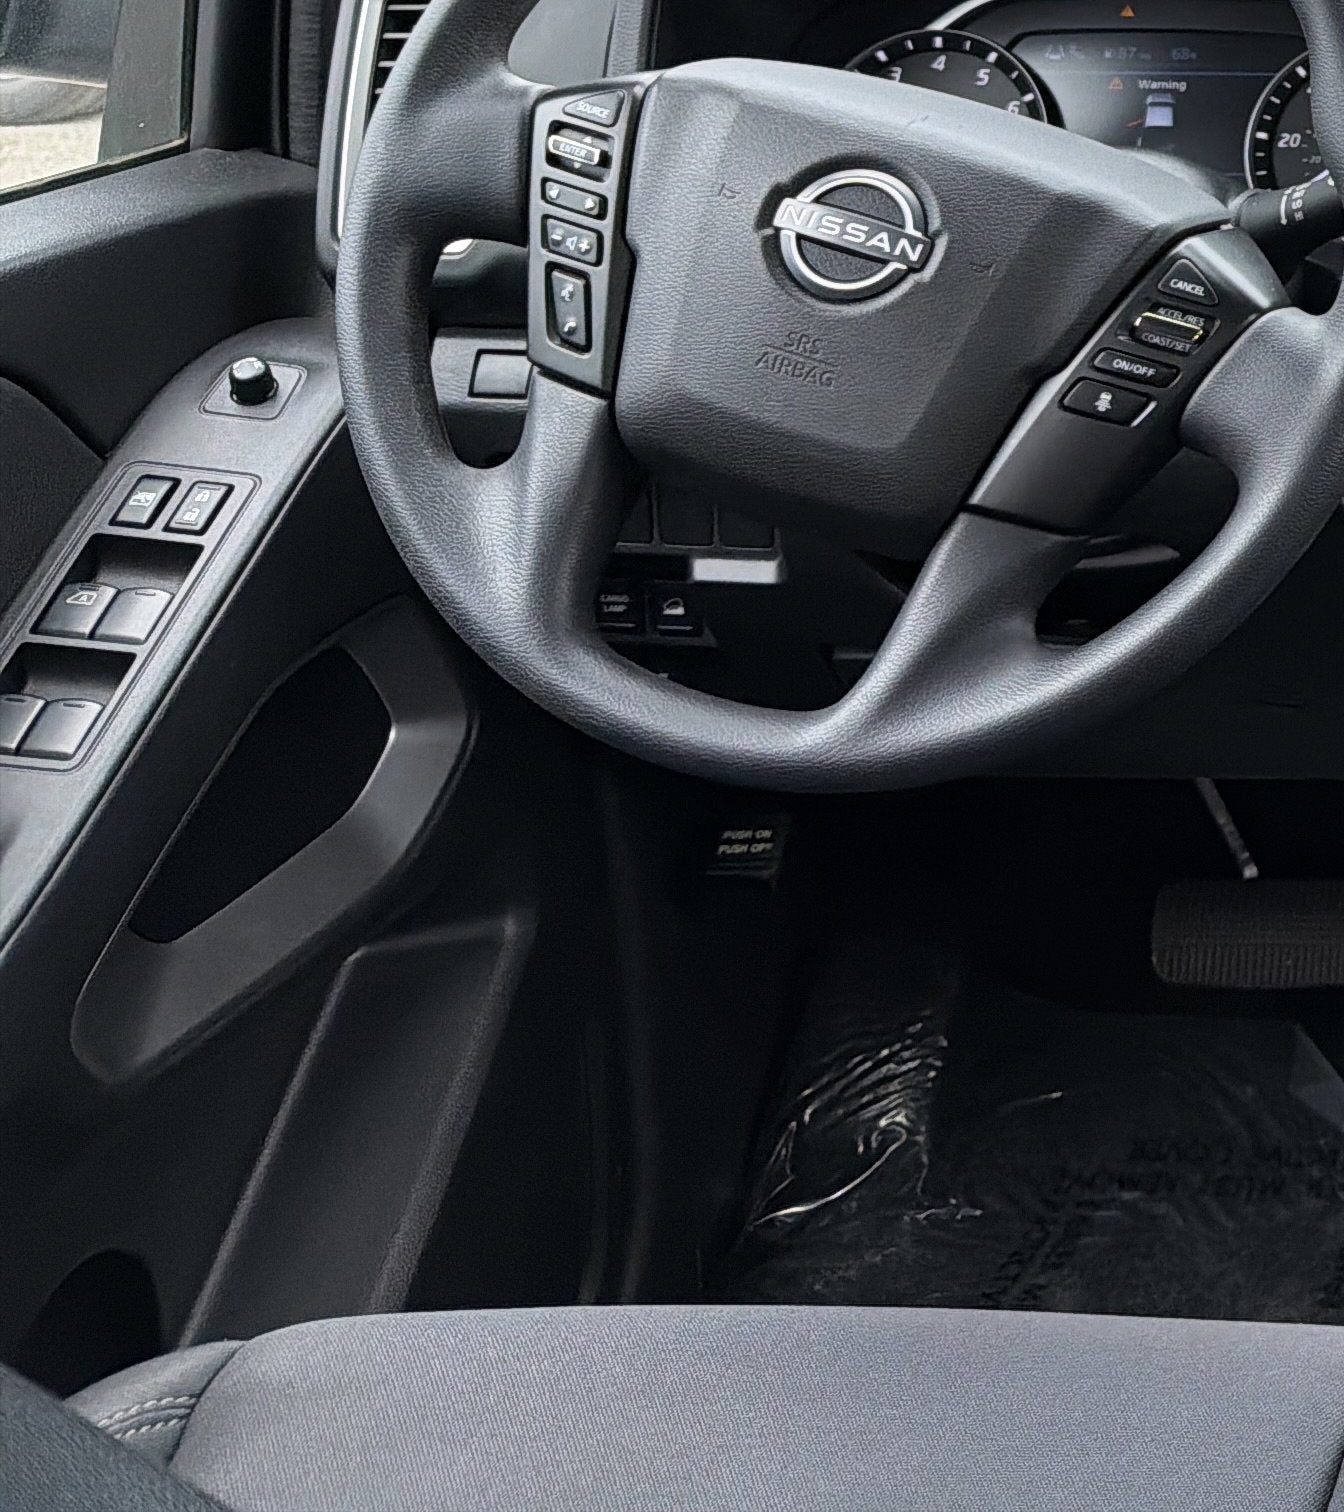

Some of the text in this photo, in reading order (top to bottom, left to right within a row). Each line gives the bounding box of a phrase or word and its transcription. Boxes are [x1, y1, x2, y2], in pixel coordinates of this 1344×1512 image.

[930, 54, 947, 72] 4
[974, 68, 991, 87] 5
[1138, 79, 1187, 93] Warning
[575, 100, 611, 119] SOURCE
[559, 142, 588, 158] ENTER
[1277, 133, 1302, 148] 20
[780, 205, 924, 262] NISSAN
[1169, 278, 1206, 297] CANCEL
[1157, 306, 1206, 327] ACCEL/RES
[783, 331, 822, 356] SRS
[1142, 332, 1193, 352] COAST/SET
[754, 350, 836, 388] AIRBAG
[1112, 358, 1157, 377] ON/OFF
